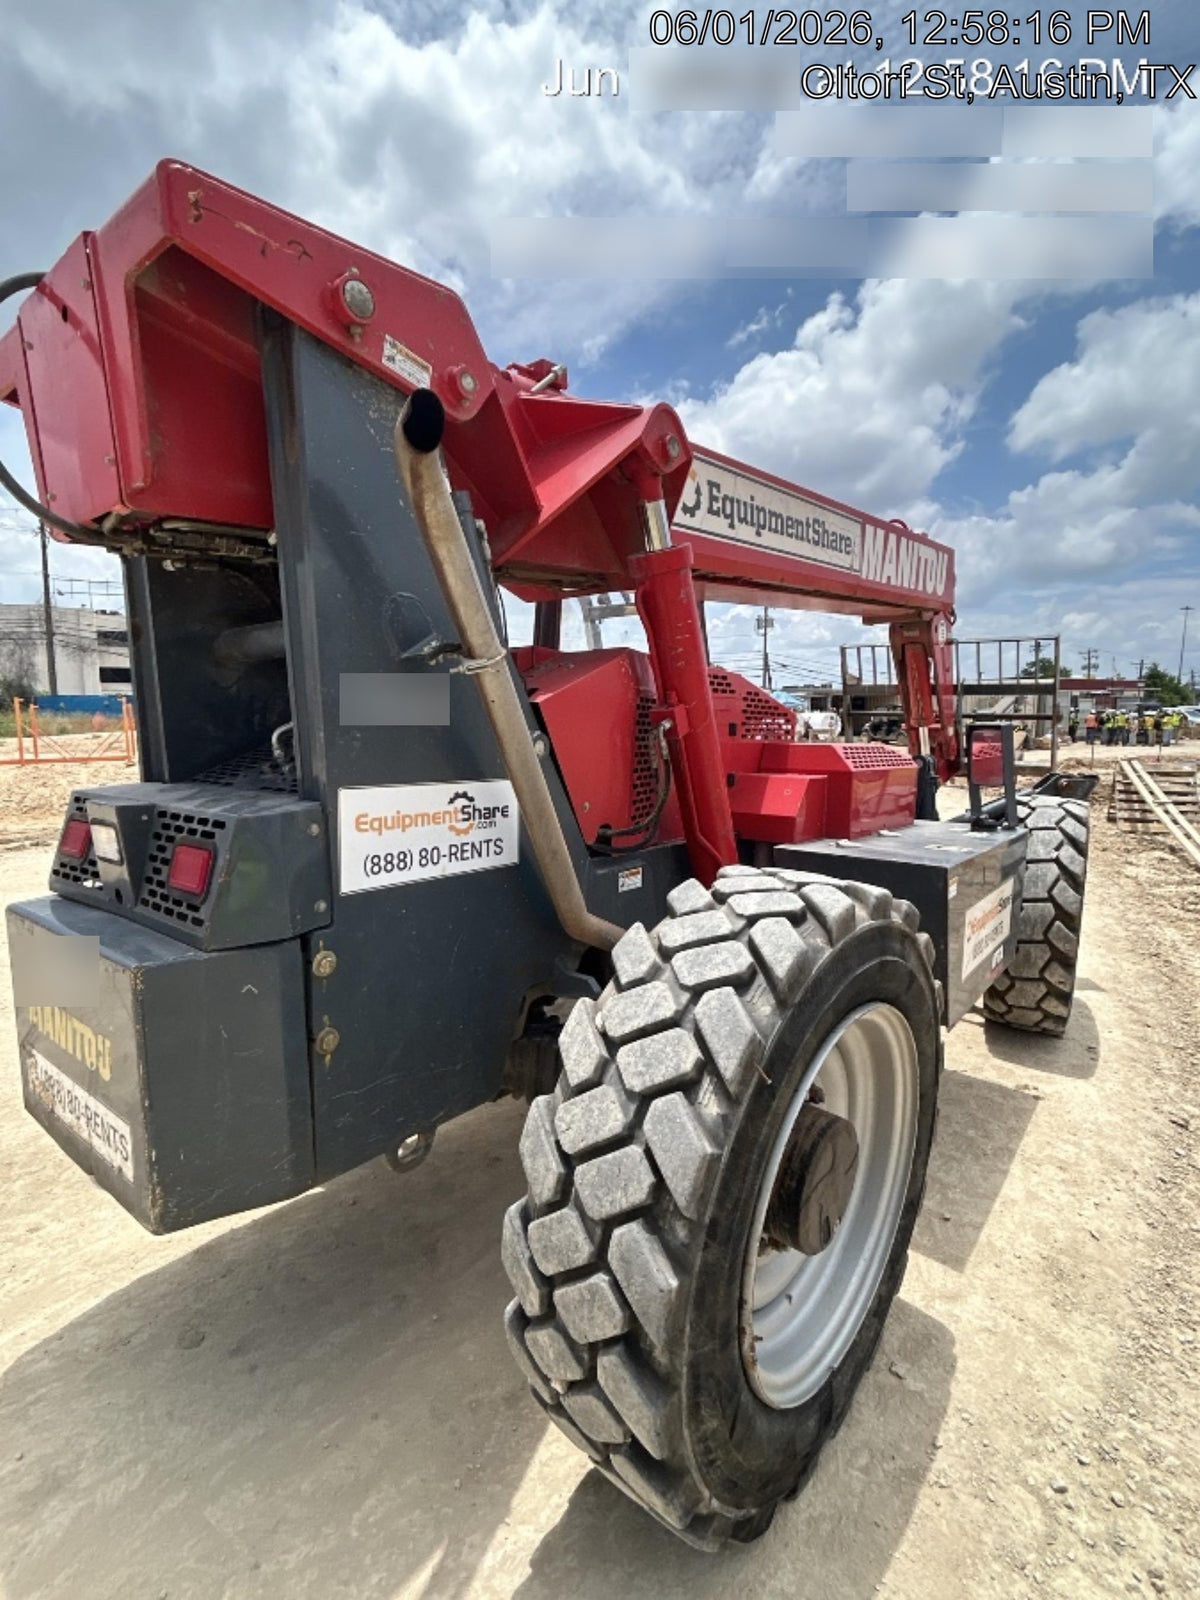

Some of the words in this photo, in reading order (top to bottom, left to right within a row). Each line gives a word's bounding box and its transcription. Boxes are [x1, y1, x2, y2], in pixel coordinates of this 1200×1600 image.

[706, 479, 852, 556] EquipmentShare
[861, 523, 949, 597] MANITOU
[354, 804, 510, 836] EquipmentShare
[363, 849, 414, 878] (888)
[418, 837, 505, 867] 80-RENTS
